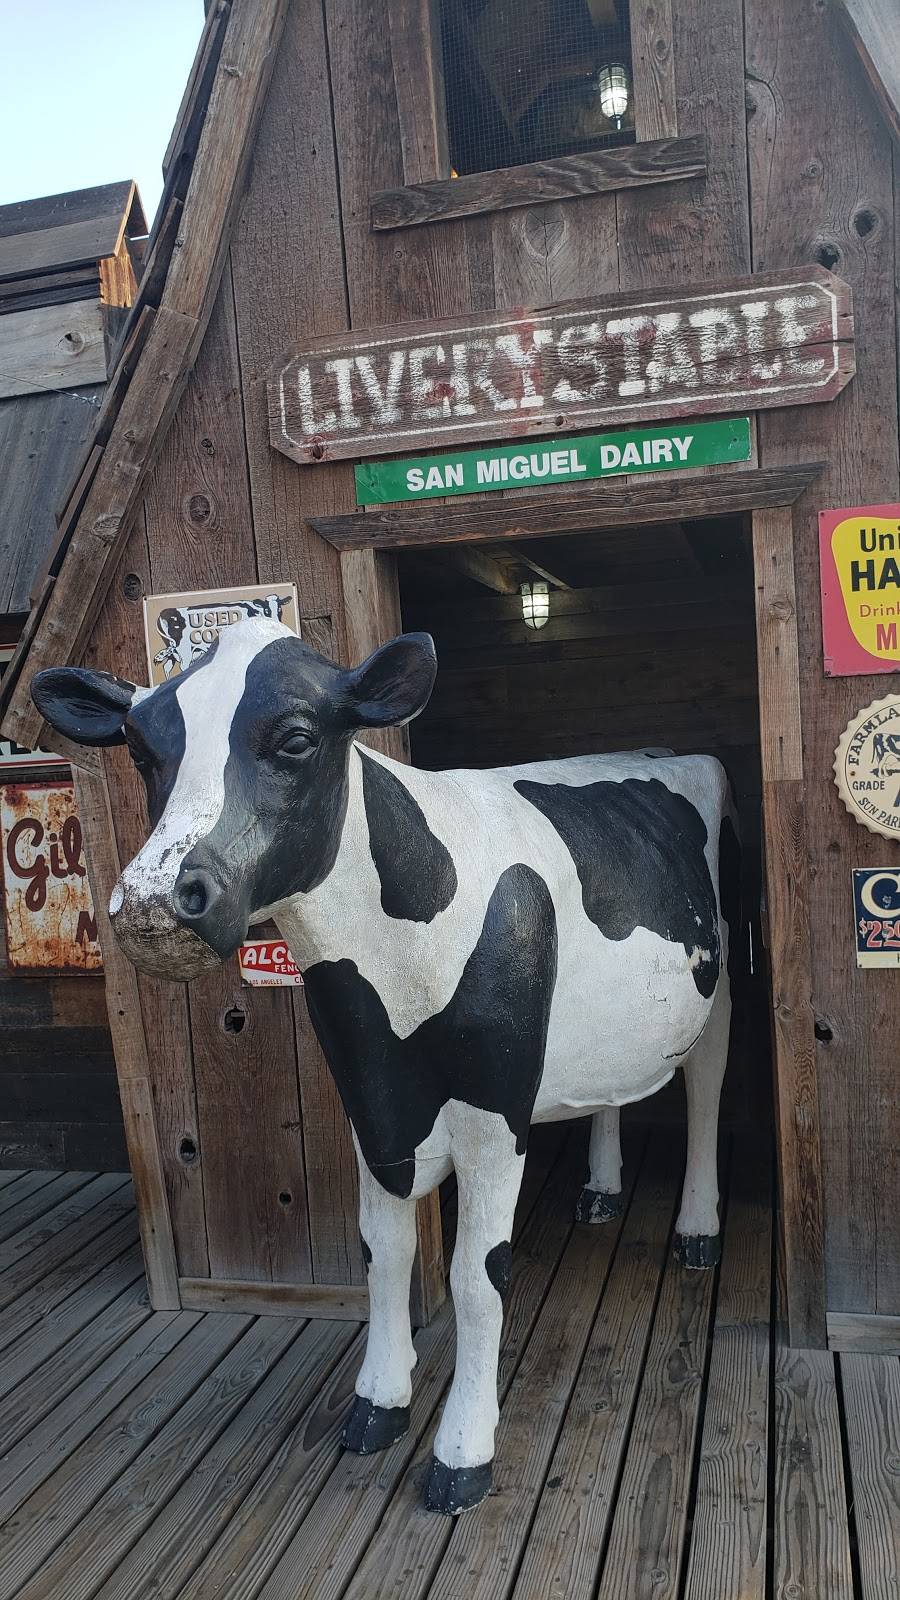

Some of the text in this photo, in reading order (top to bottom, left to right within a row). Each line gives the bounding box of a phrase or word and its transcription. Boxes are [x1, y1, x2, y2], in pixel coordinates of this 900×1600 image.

[406, 436, 694, 492] SAN MIGUEL DAIRY
[851, 557, 900, 592] HA
[188, 610, 242, 628] USED
[190, 628, 222, 644] CO
[876, 623, 897, 650] M
[852, 780, 885, 790] GRADE
[858, 797, 900, 828] SUN PAR
